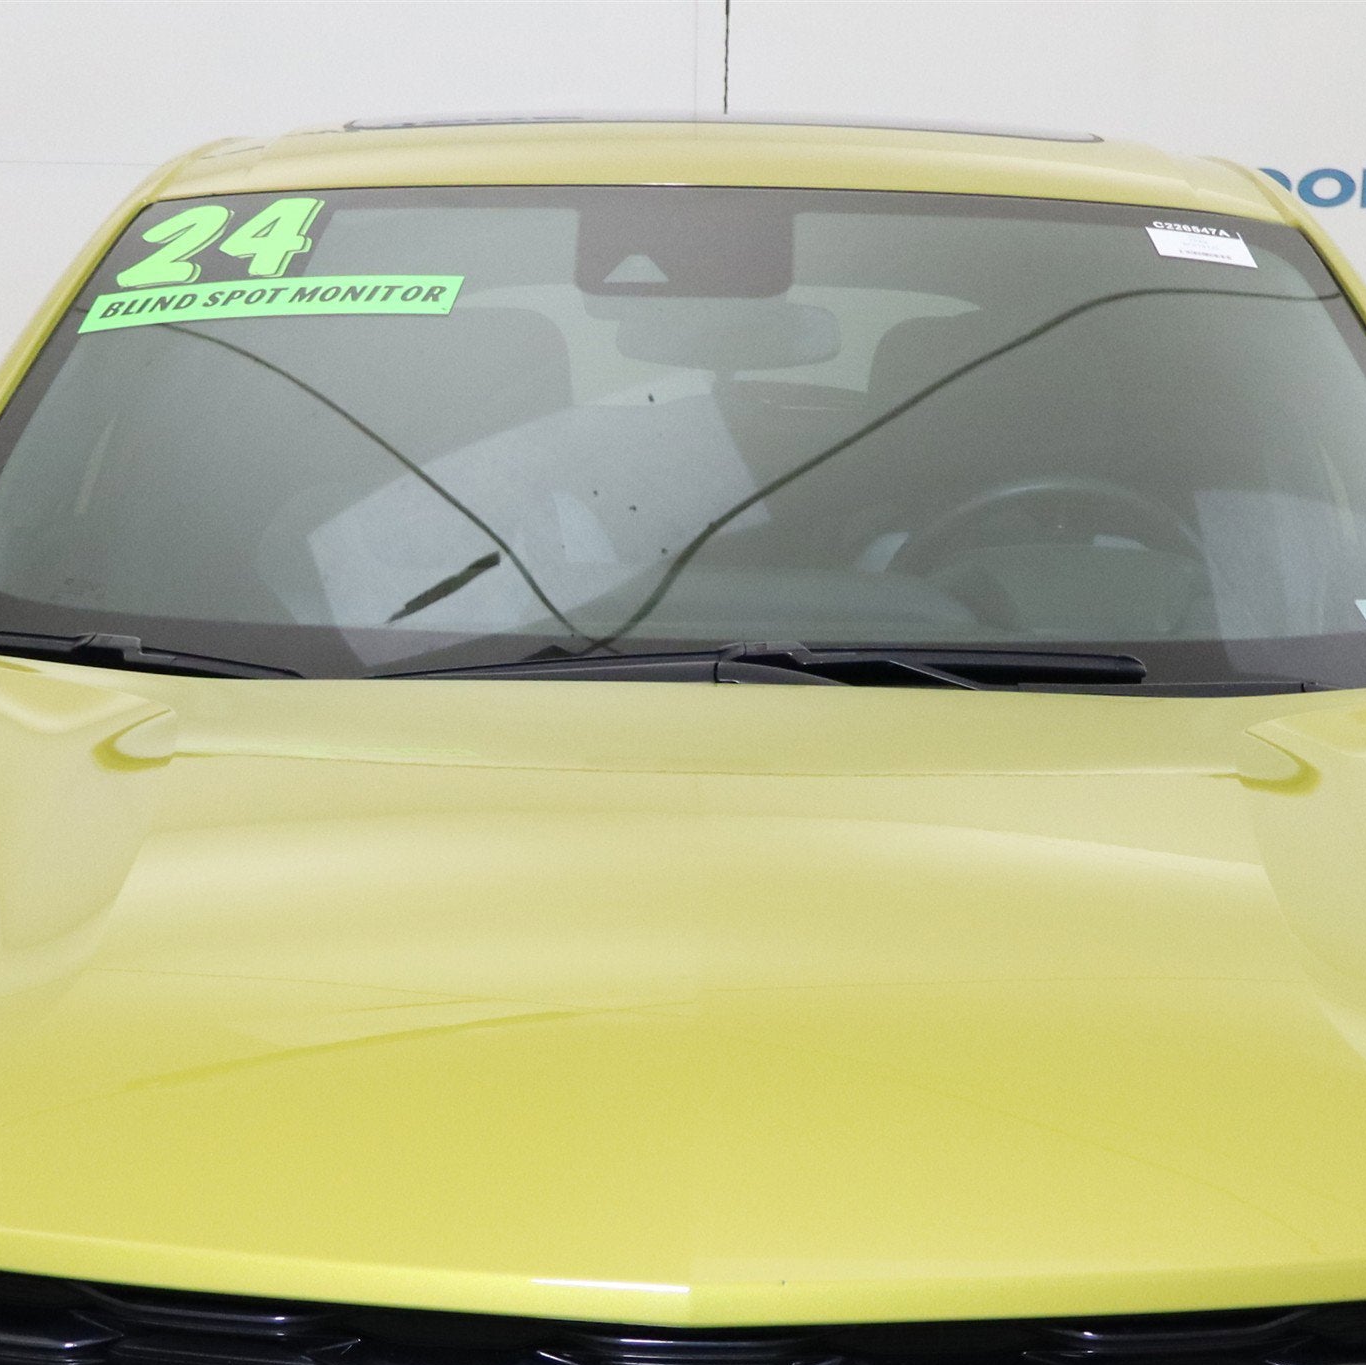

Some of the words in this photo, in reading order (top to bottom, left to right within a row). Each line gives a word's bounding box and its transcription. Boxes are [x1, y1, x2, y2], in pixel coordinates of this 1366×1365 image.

[116, 197, 326, 288] 24
[98, 293, 198, 320] BLIND
[202, 287, 289, 308] SPOT
[289, 285, 447, 304] MONITOR
